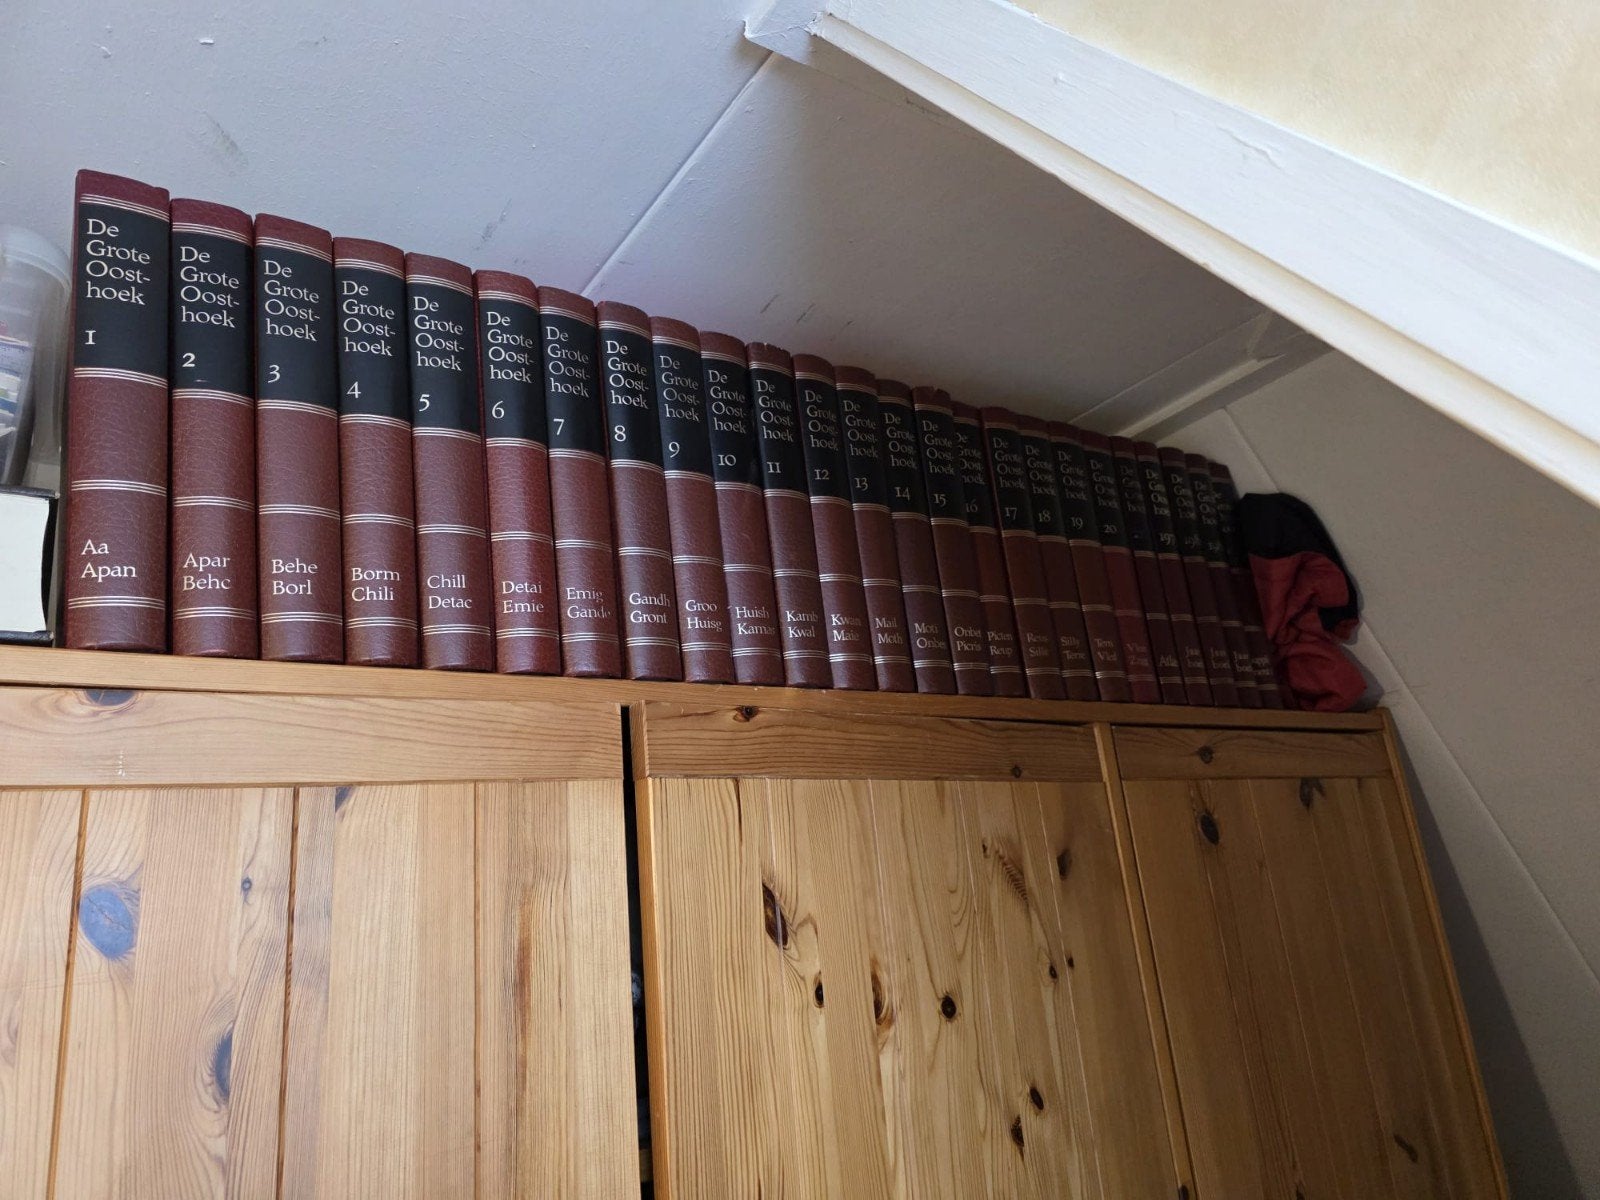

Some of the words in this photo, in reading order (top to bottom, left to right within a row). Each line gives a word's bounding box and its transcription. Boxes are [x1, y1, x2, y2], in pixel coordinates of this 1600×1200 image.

[87, 219, 119, 237] De
[86, 240, 150, 264] Grote
[180, 247, 210, 262] De
[86, 261, 150, 283] Oost-
[264, 260, 292, 278] De
[180, 266, 239, 289] Grote
[86, 281, 146, 305] hoek
[264, 280, 319, 303] Grote
[342, 281, 368, 296] De
[181, 286, 240, 308] Oost-
[414, 296, 439, 312] De
[181, 306, 236, 328] hoek
[265, 299, 320, 321] Oost-
[343, 299, 395, 320] Grote
[414, 315, 463, 335] Grote
[486, 312, 511, 326] De
[266, 318, 317, 341] hoek
[344, 318, 396, 337] Oost-
[546, 326, 568, 341] De
[344, 337, 392, 356] hoek
[415, 333, 464, 352] Oost-
[488, 329, 533, 348] Grote
[488, 346, 534, 365] Oost-
[548, 344, 589, 364] Grote
[606, 341, 628, 354] De
[182, 353, 196, 367] 2
[416, 351, 462, 371] hoek
[608, 357, 647, 376] Grote
[660, 356, 680, 369] De
[268, 365, 280, 383] 3
[490, 365, 532, 383] hoek
[549, 361, 590, 380] Oost-
[708, 370, 728, 383] De
[550, 378, 589, 398] hoek
[609, 374, 649, 392] Oost-
[662, 372, 698, 390] Grote
[756, 380, 775, 393] De
[347, 381, 361, 398] 4
[663, 388, 700, 405] Oost-
[710, 386, 745, 404] Grote
[805, 390, 822, 402] De
[419, 394, 430, 411] 5
[611, 390, 648, 409] hoek
[759, 395, 792, 412] Grote
[843, 400, 860, 412] De
[492, 401, 504, 418] 6
[664, 404, 700, 421] hoek
[712, 402, 746, 418] Oost-
[807, 405, 837, 422] Grote
[553, 418, 564, 435] 7
[714, 418, 746, 434] hoek
[846, 415, 876, 430] Grote
[884, 413, 901, 424] De
[922, 420, 938, 431] De
[614, 425, 626, 442] 8
[762, 426, 793, 442] hoek
[668, 442, 680, 458] 9
[810, 435, 838, 451] hoek
[850, 444, 878, 458] hoek
[993, 438, 1008, 448] De
[1025, 445, 1039, 456] De
[814, 469, 829, 480] 12
[854, 478, 868, 491] 13
[894, 487, 910, 501] 14
[934, 494, 946, 507] 15
[966, 499, 978, 512] 16
[1005, 507, 1017, 520] 17
[1039, 510, 1050, 522] 18
[81, 540, 109, 555] Aa
[184, 553, 230, 571] Apar
[272, 558, 318, 574] Behe
[81, 563, 137, 582] Apan
[352, 567, 400, 581] Borm
[273, 580, 312, 595] Borl
[427, 575, 466, 589] Chill
[502, 581, 542, 594] Detai
[352, 586, 394, 601] Chili
[566, 588, 603, 603] Emig
[630, 593, 670, 607] Gandh
[428, 596, 472, 609] Detac
[685, 600, 717, 612] Groo
[630, 611, 667, 624] Gront
[735, 606, 769, 619] Huish
[687, 617, 722, 632] Huisg
[788, 626, 815, 638] Kwal
